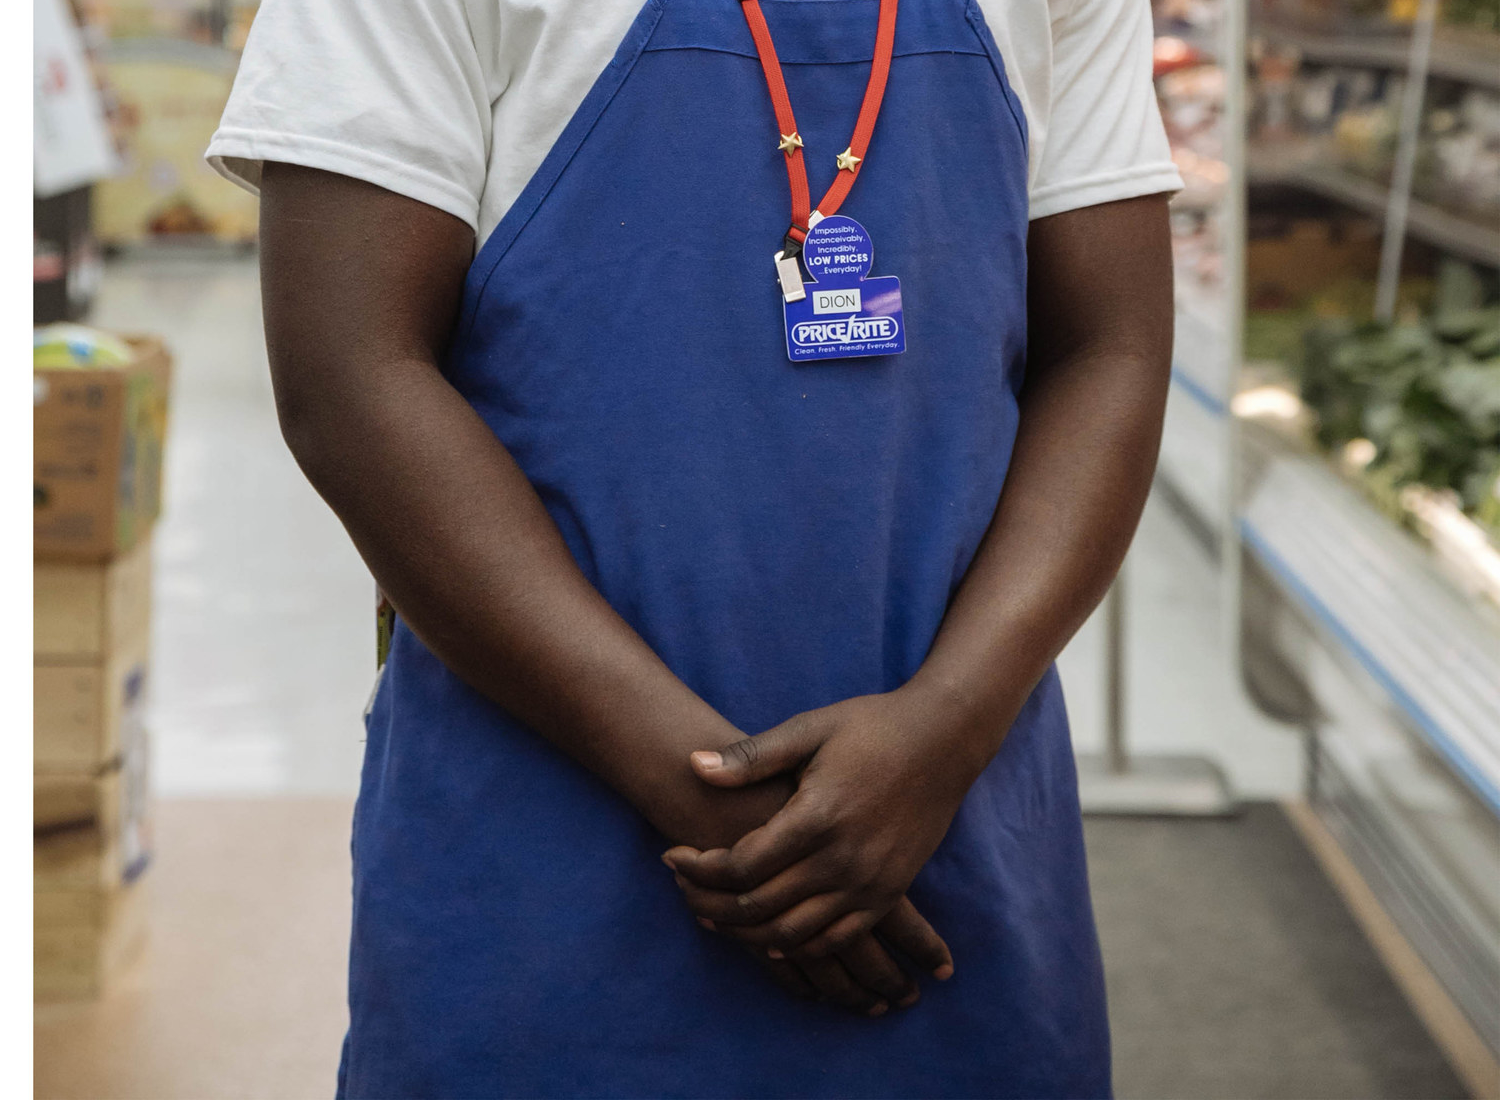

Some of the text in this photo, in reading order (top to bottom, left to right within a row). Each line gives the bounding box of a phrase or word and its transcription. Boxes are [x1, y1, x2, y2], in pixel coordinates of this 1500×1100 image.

[809, 253, 868, 266] LOW PRICES
[820, 295, 855, 309] DION
[840, 344, 865, 352] Friendly
